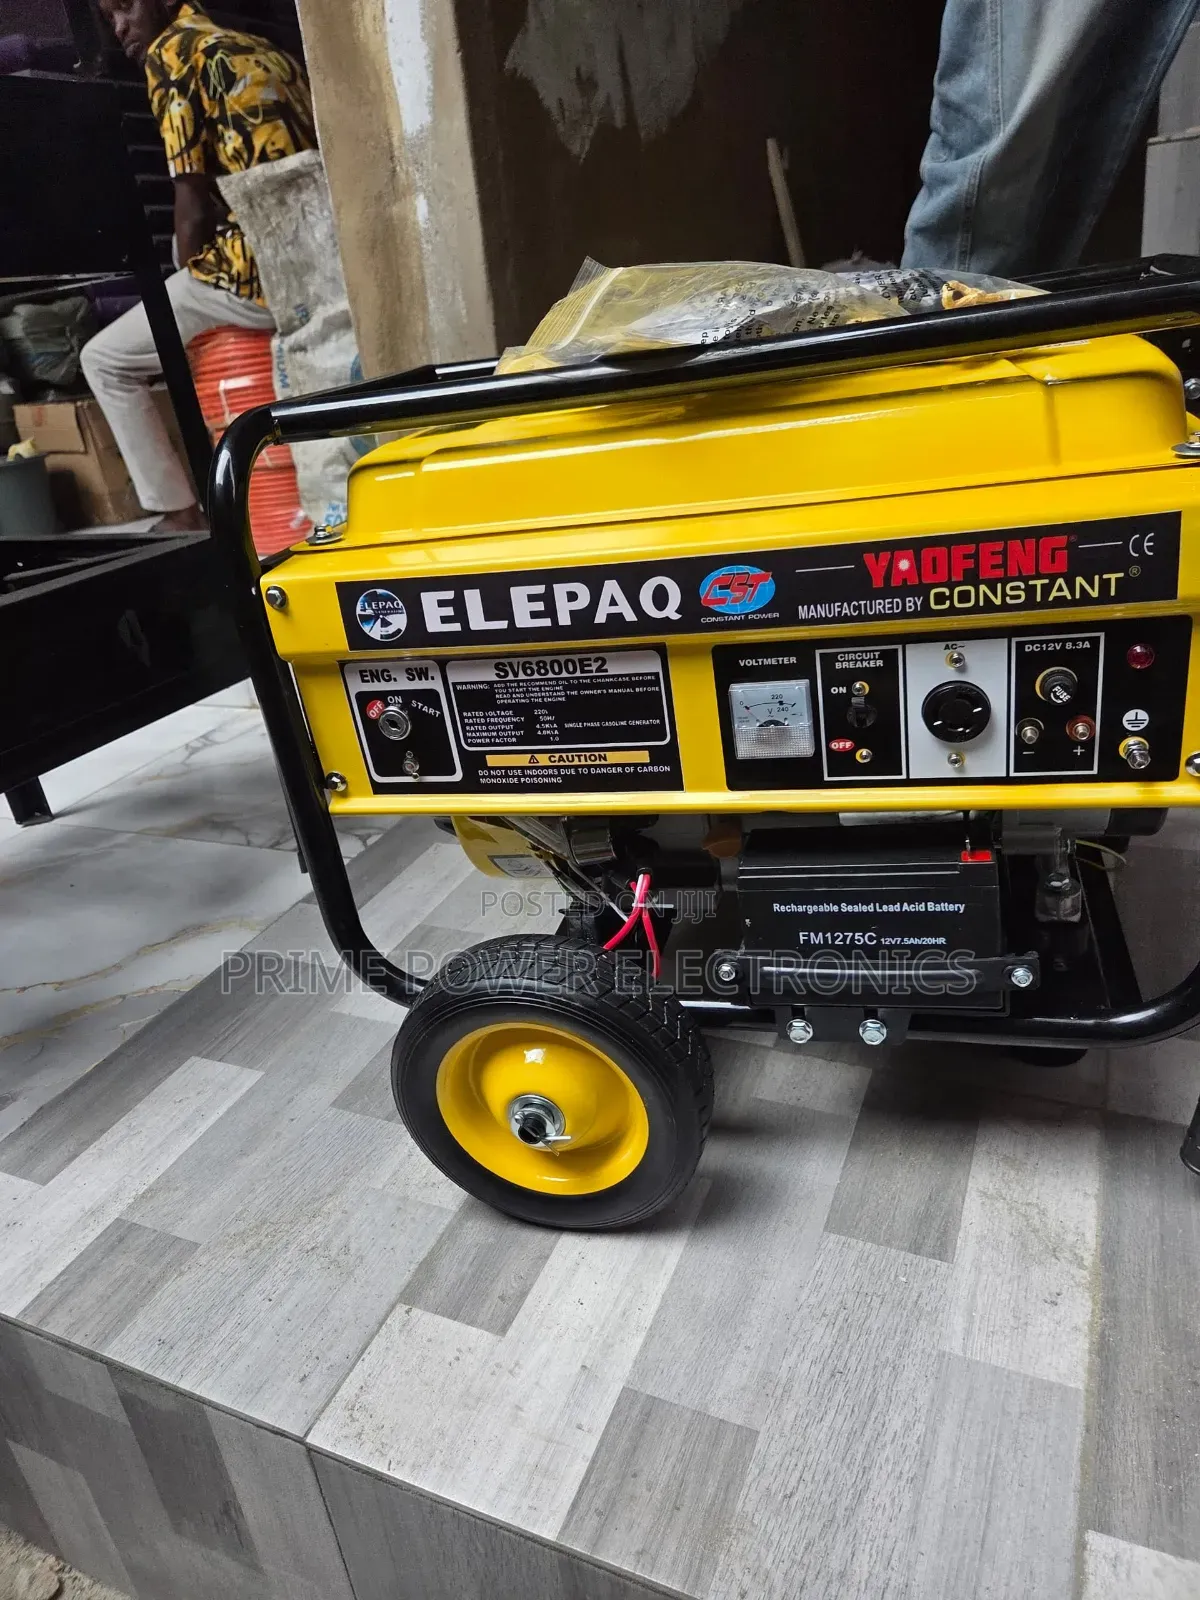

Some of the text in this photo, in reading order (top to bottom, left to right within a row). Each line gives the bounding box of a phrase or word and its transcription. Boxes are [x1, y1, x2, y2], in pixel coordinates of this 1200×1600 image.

[1129, 533, 1154, 557] CE
[863, 535, 1068, 588] YAOFENG
[701, 571, 772, 607] CST
[798, 572, 1124, 620] MANUFACTURED BY CONSTANT
[359, 600, 403, 610] ELEPAQ
[420, 576, 682, 633] ELEPAQ
[700, 612, 780, 624] CONSTANT POWER
[1024, 641, 1091, 652] DC12V 8.3A
[739, 656, 797, 667] VOLTMETER
[837, 651, 881, 661] CIRCUIT
[494, 656, 609, 679] SV6800E2
[835, 660, 884, 669] BREAKER
[358, 667, 435, 684] ENG. SW.
[456, 683, 491, 691] WARNING:
[830, 686, 847, 695] ON
[387, 695, 403, 704] ON
[1052, 685, 1072, 703] FUSE
[369, 700, 385, 718] OFF
[411, 700, 441, 718] START
[487, 716, 525, 724] FREQUENCY
[831, 741, 852, 750] OFF
[548, 753, 608, 764] CAUTION
[524, 768, 559, 776] INDOORS
[590, 766, 623, 774] DANGER
[637, 765, 671, 773] CARBON
[521, 776, 563, 784] POISONING
[773, 901, 966, 914] Rechargeable Sealed Lead Acid Battery
[800, 932, 947, 945] FM1275C 12V7.5Ah/20HR
